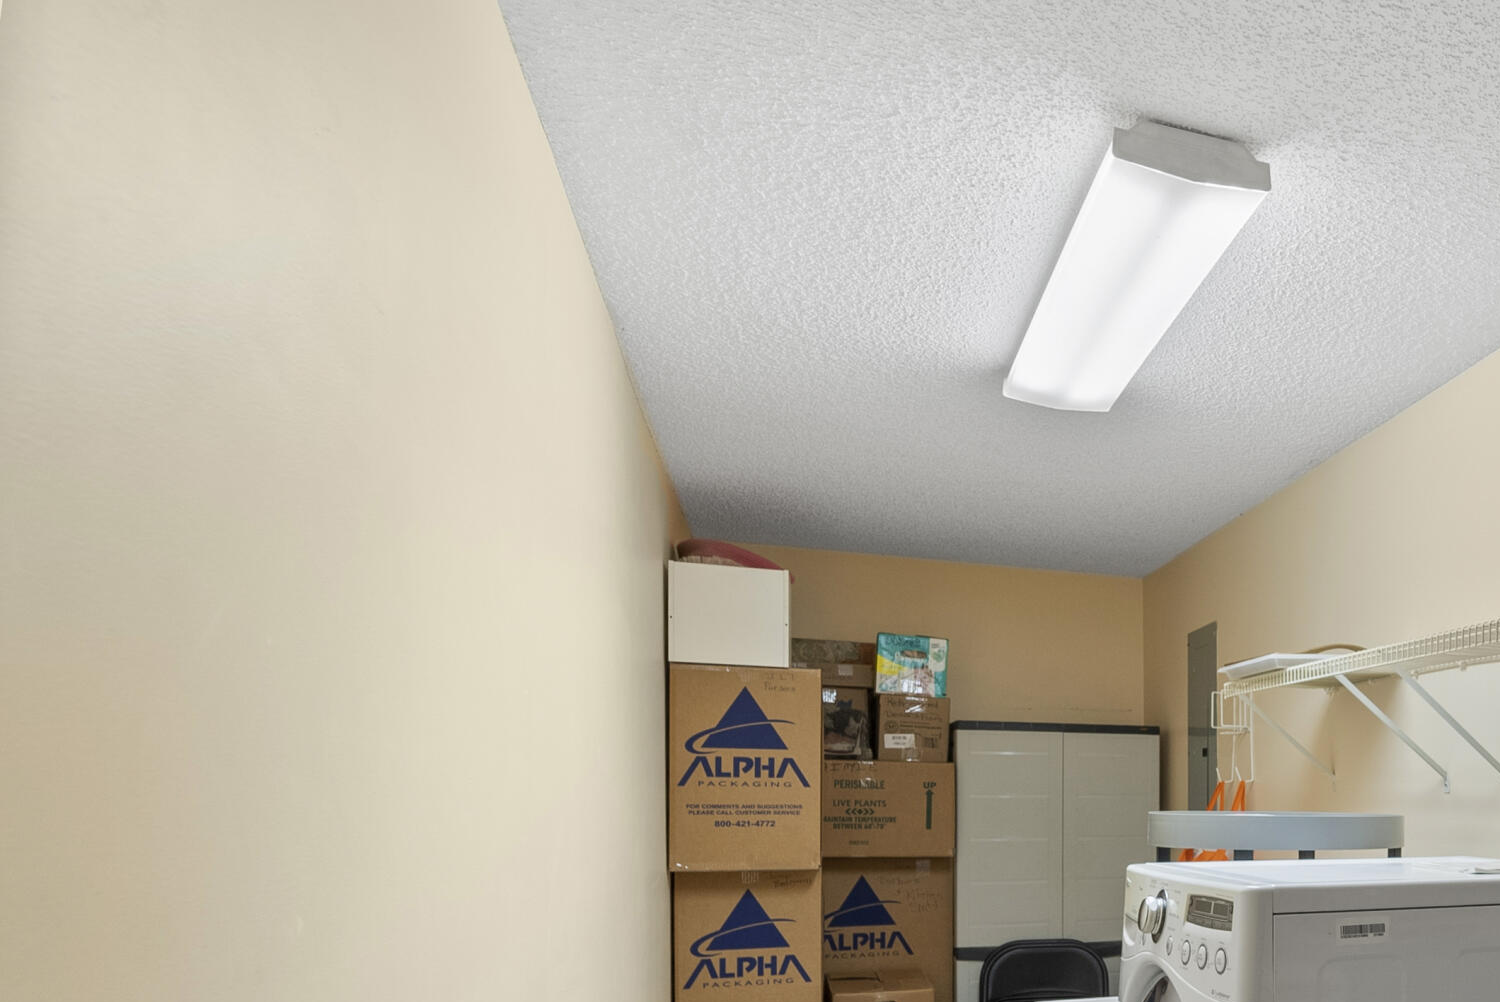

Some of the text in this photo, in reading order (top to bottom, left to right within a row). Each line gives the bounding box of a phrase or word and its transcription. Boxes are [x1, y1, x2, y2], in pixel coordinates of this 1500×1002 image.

[677, 756, 811, 788] ALPHA
[714, 820, 776, 828] 800-421-4772
[683, 955, 812, 989] ALPHA
[702, 978, 794, 989] PACKAGING
